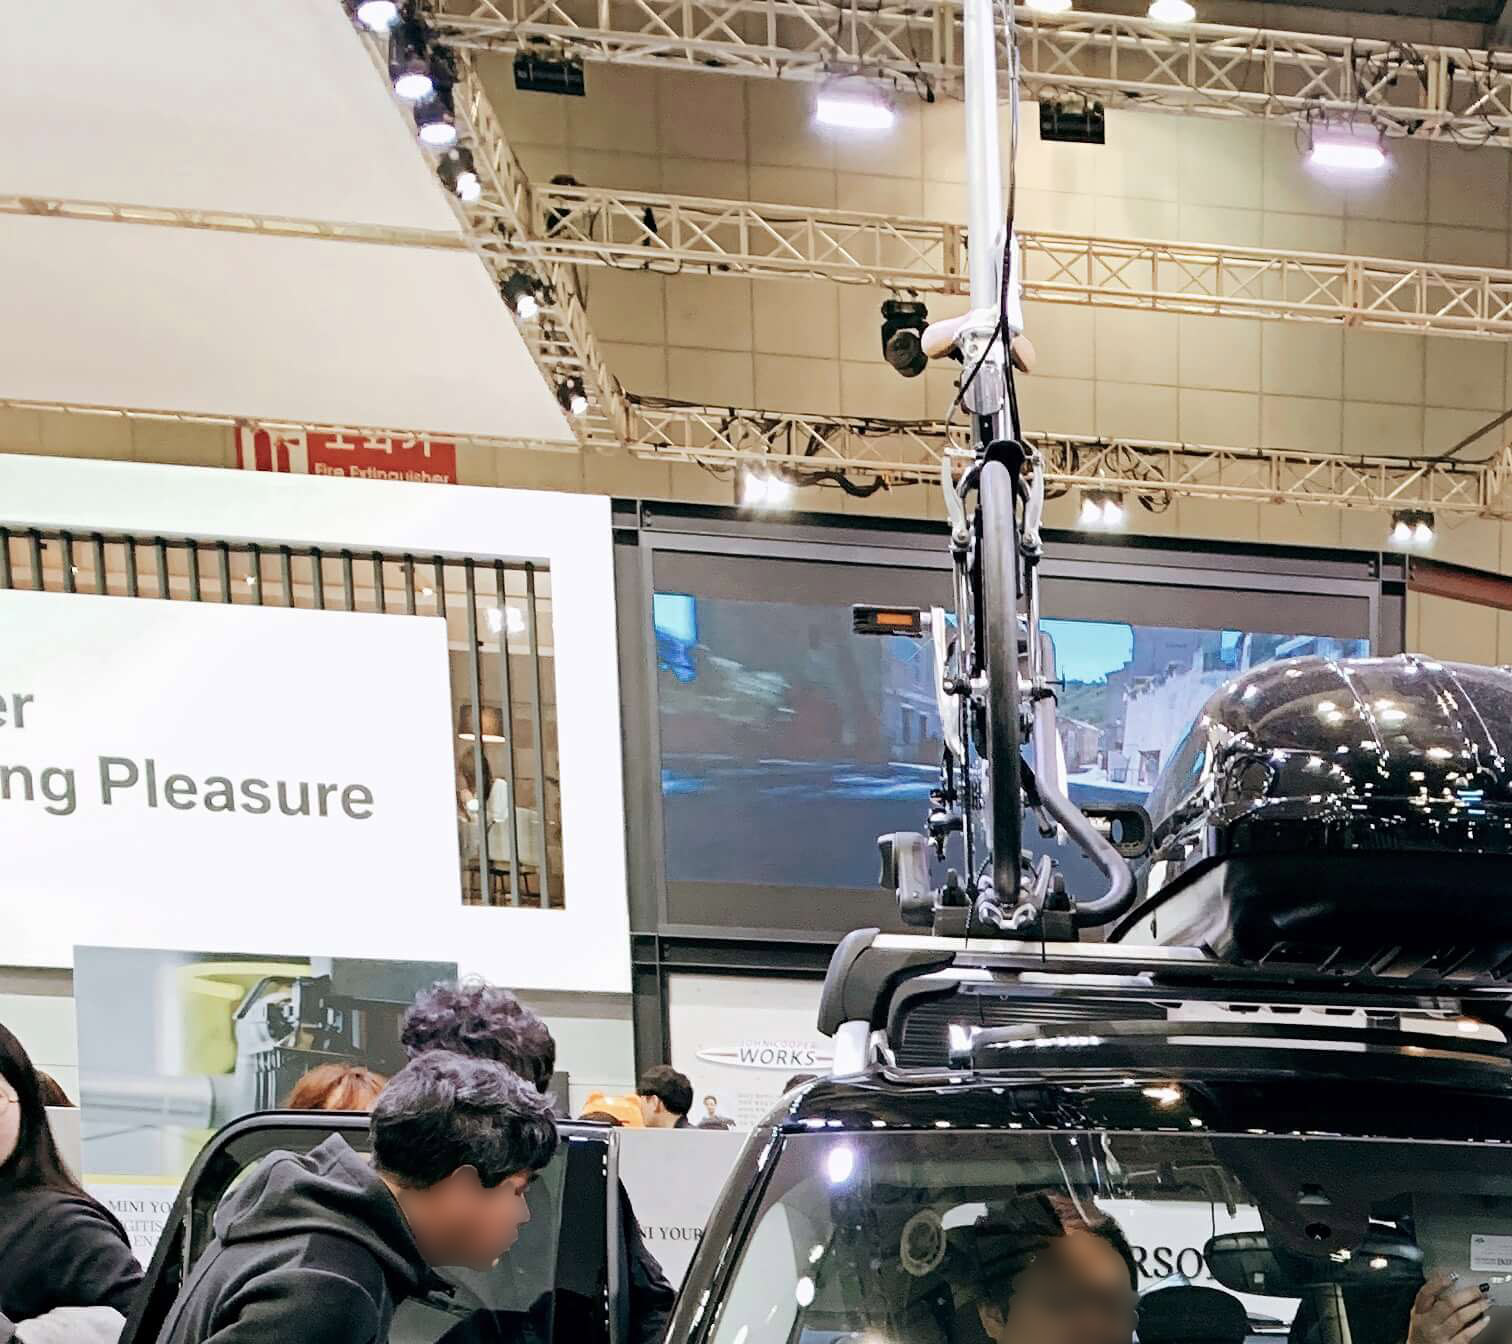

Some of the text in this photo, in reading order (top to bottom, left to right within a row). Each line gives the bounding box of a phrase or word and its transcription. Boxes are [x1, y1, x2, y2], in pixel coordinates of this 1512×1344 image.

[0, 692, 34, 728] r
[98, 755, 375, 820] Pleasure
[740, 1048, 816, 1066] WORKS
[150, 1200, 174, 1214] YO
[1130, 1246, 1213, 1280] RSO
